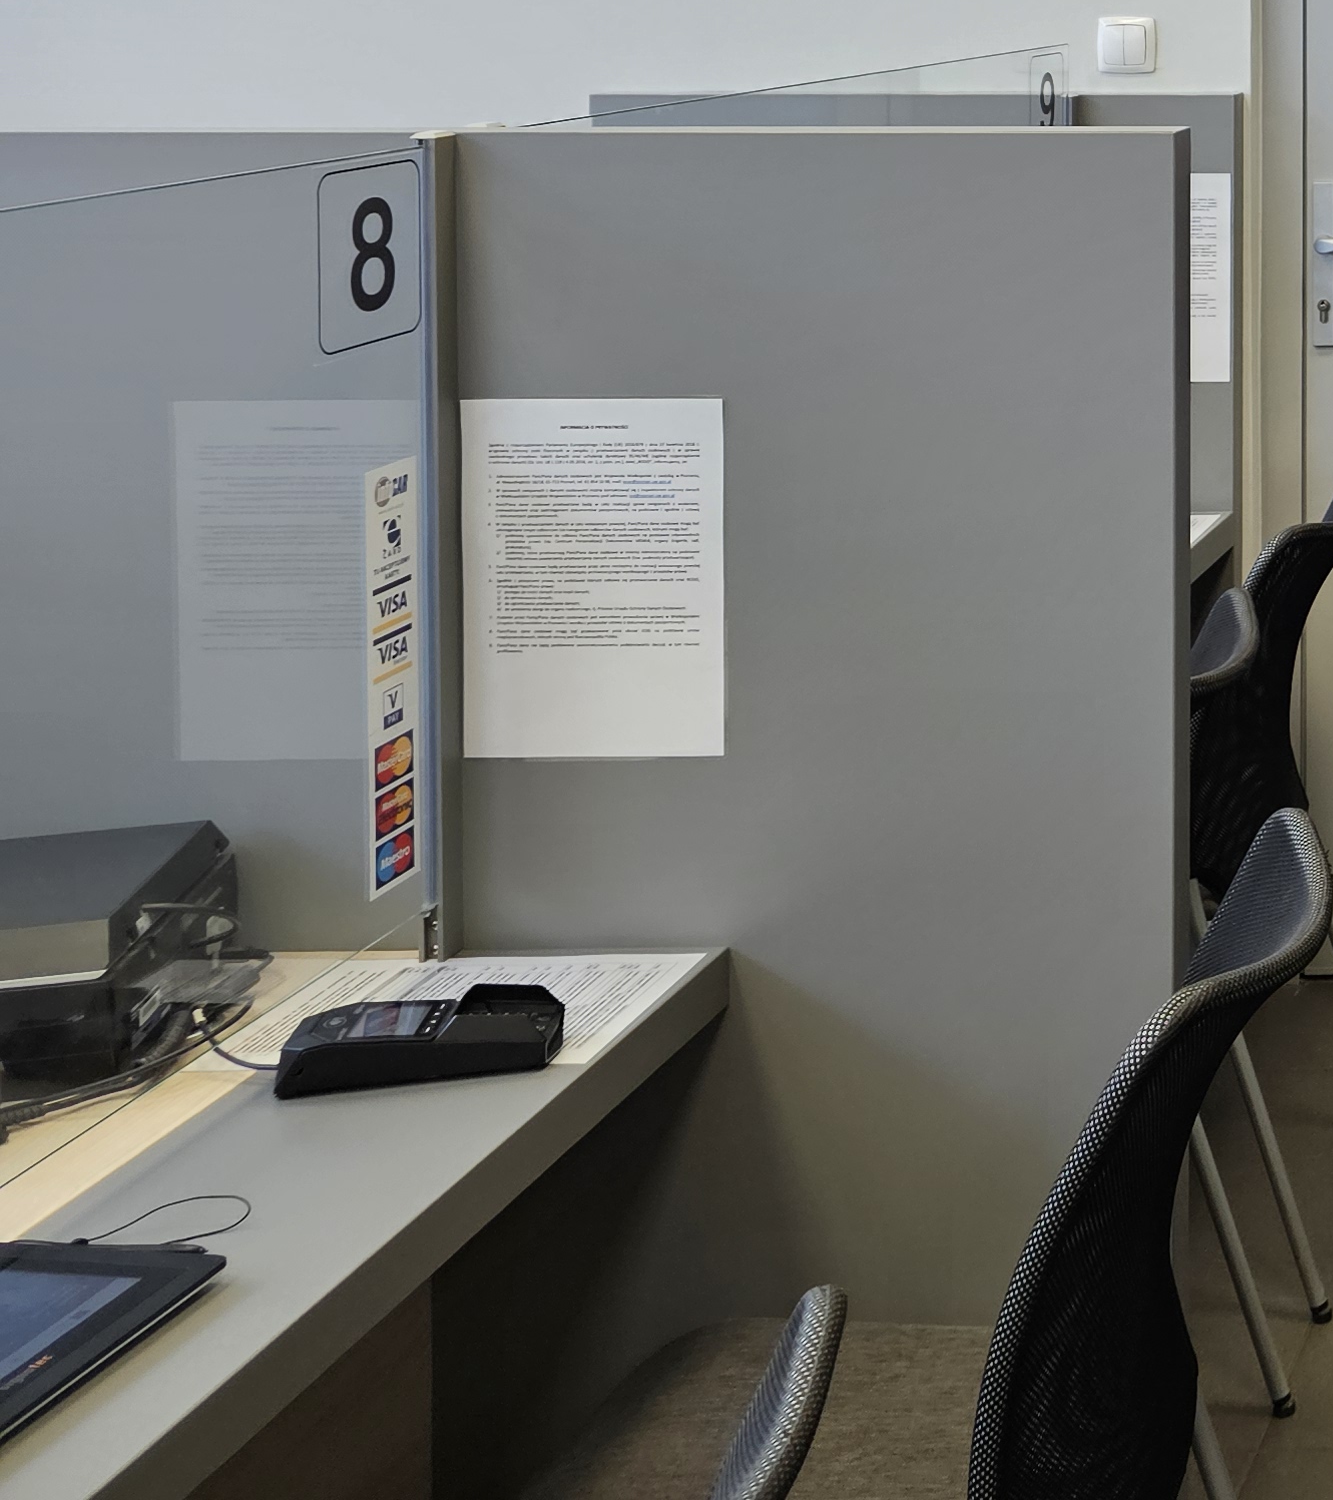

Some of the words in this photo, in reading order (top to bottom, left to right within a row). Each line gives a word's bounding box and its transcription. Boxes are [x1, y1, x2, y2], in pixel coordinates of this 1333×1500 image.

[1039, 71, 1056, 126] 9
[350, 197, 396, 312] 8
[377, 590, 408, 618] VISA
[377, 636, 408, 665] VISA
[381, 845, 411, 870] Maestro
